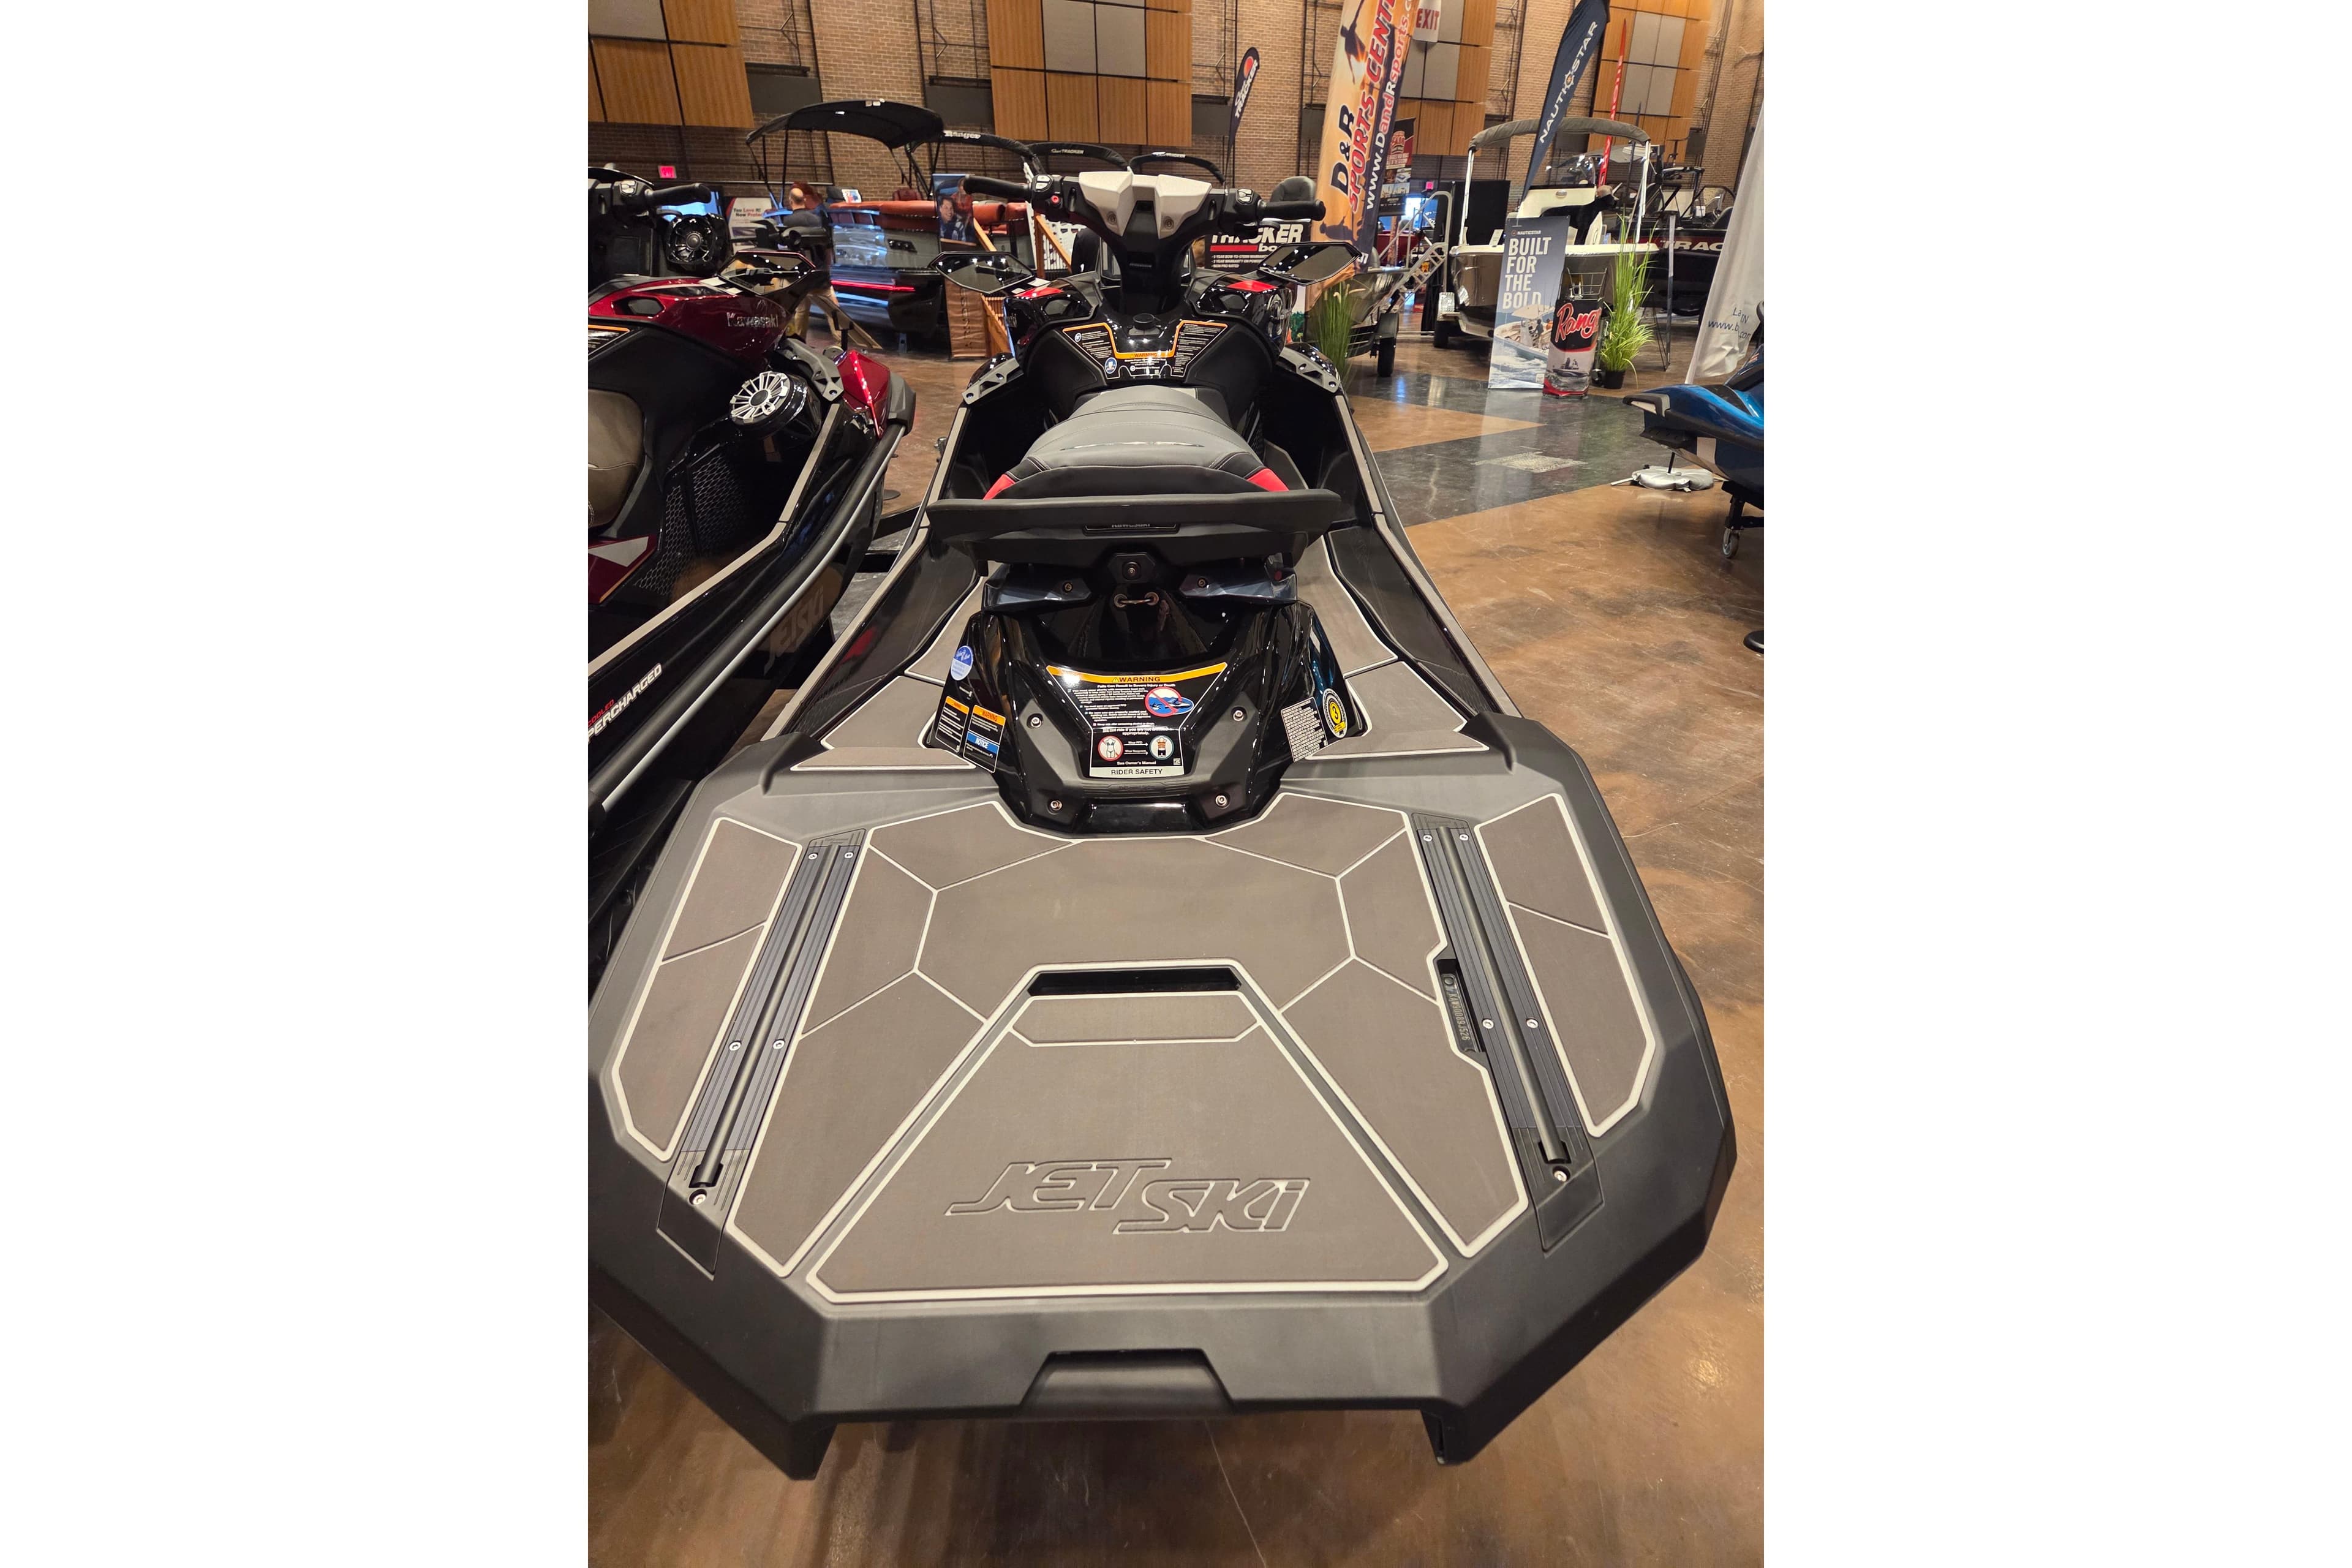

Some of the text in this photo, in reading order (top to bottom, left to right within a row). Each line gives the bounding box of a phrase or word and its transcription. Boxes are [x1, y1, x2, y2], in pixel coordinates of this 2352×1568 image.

[1415, 8, 1439, 30] EXIT
[1348, 0, 1395, 213] SPORTS CENT
[1366, 0, 1412, 209] www.DandRsports.c
[944, 130, 981, 139] Ranger
[1508, 237, 1551, 256] BUILT
[1660, 240, 1724, 251] TRAC
[1506, 256, 1537, 274] FOR
[1505, 274, 1532, 292] THE
[1502, 292, 1542, 309] BOLD
[1555, 303, 1602, 342] Rang
[588, 663, 662, 744] PERCHARGED
[588, 699, 614, 727] COOLED
[1332, 706, 1338, 720] 3
[944, 1158, 1172, 1216] JET
